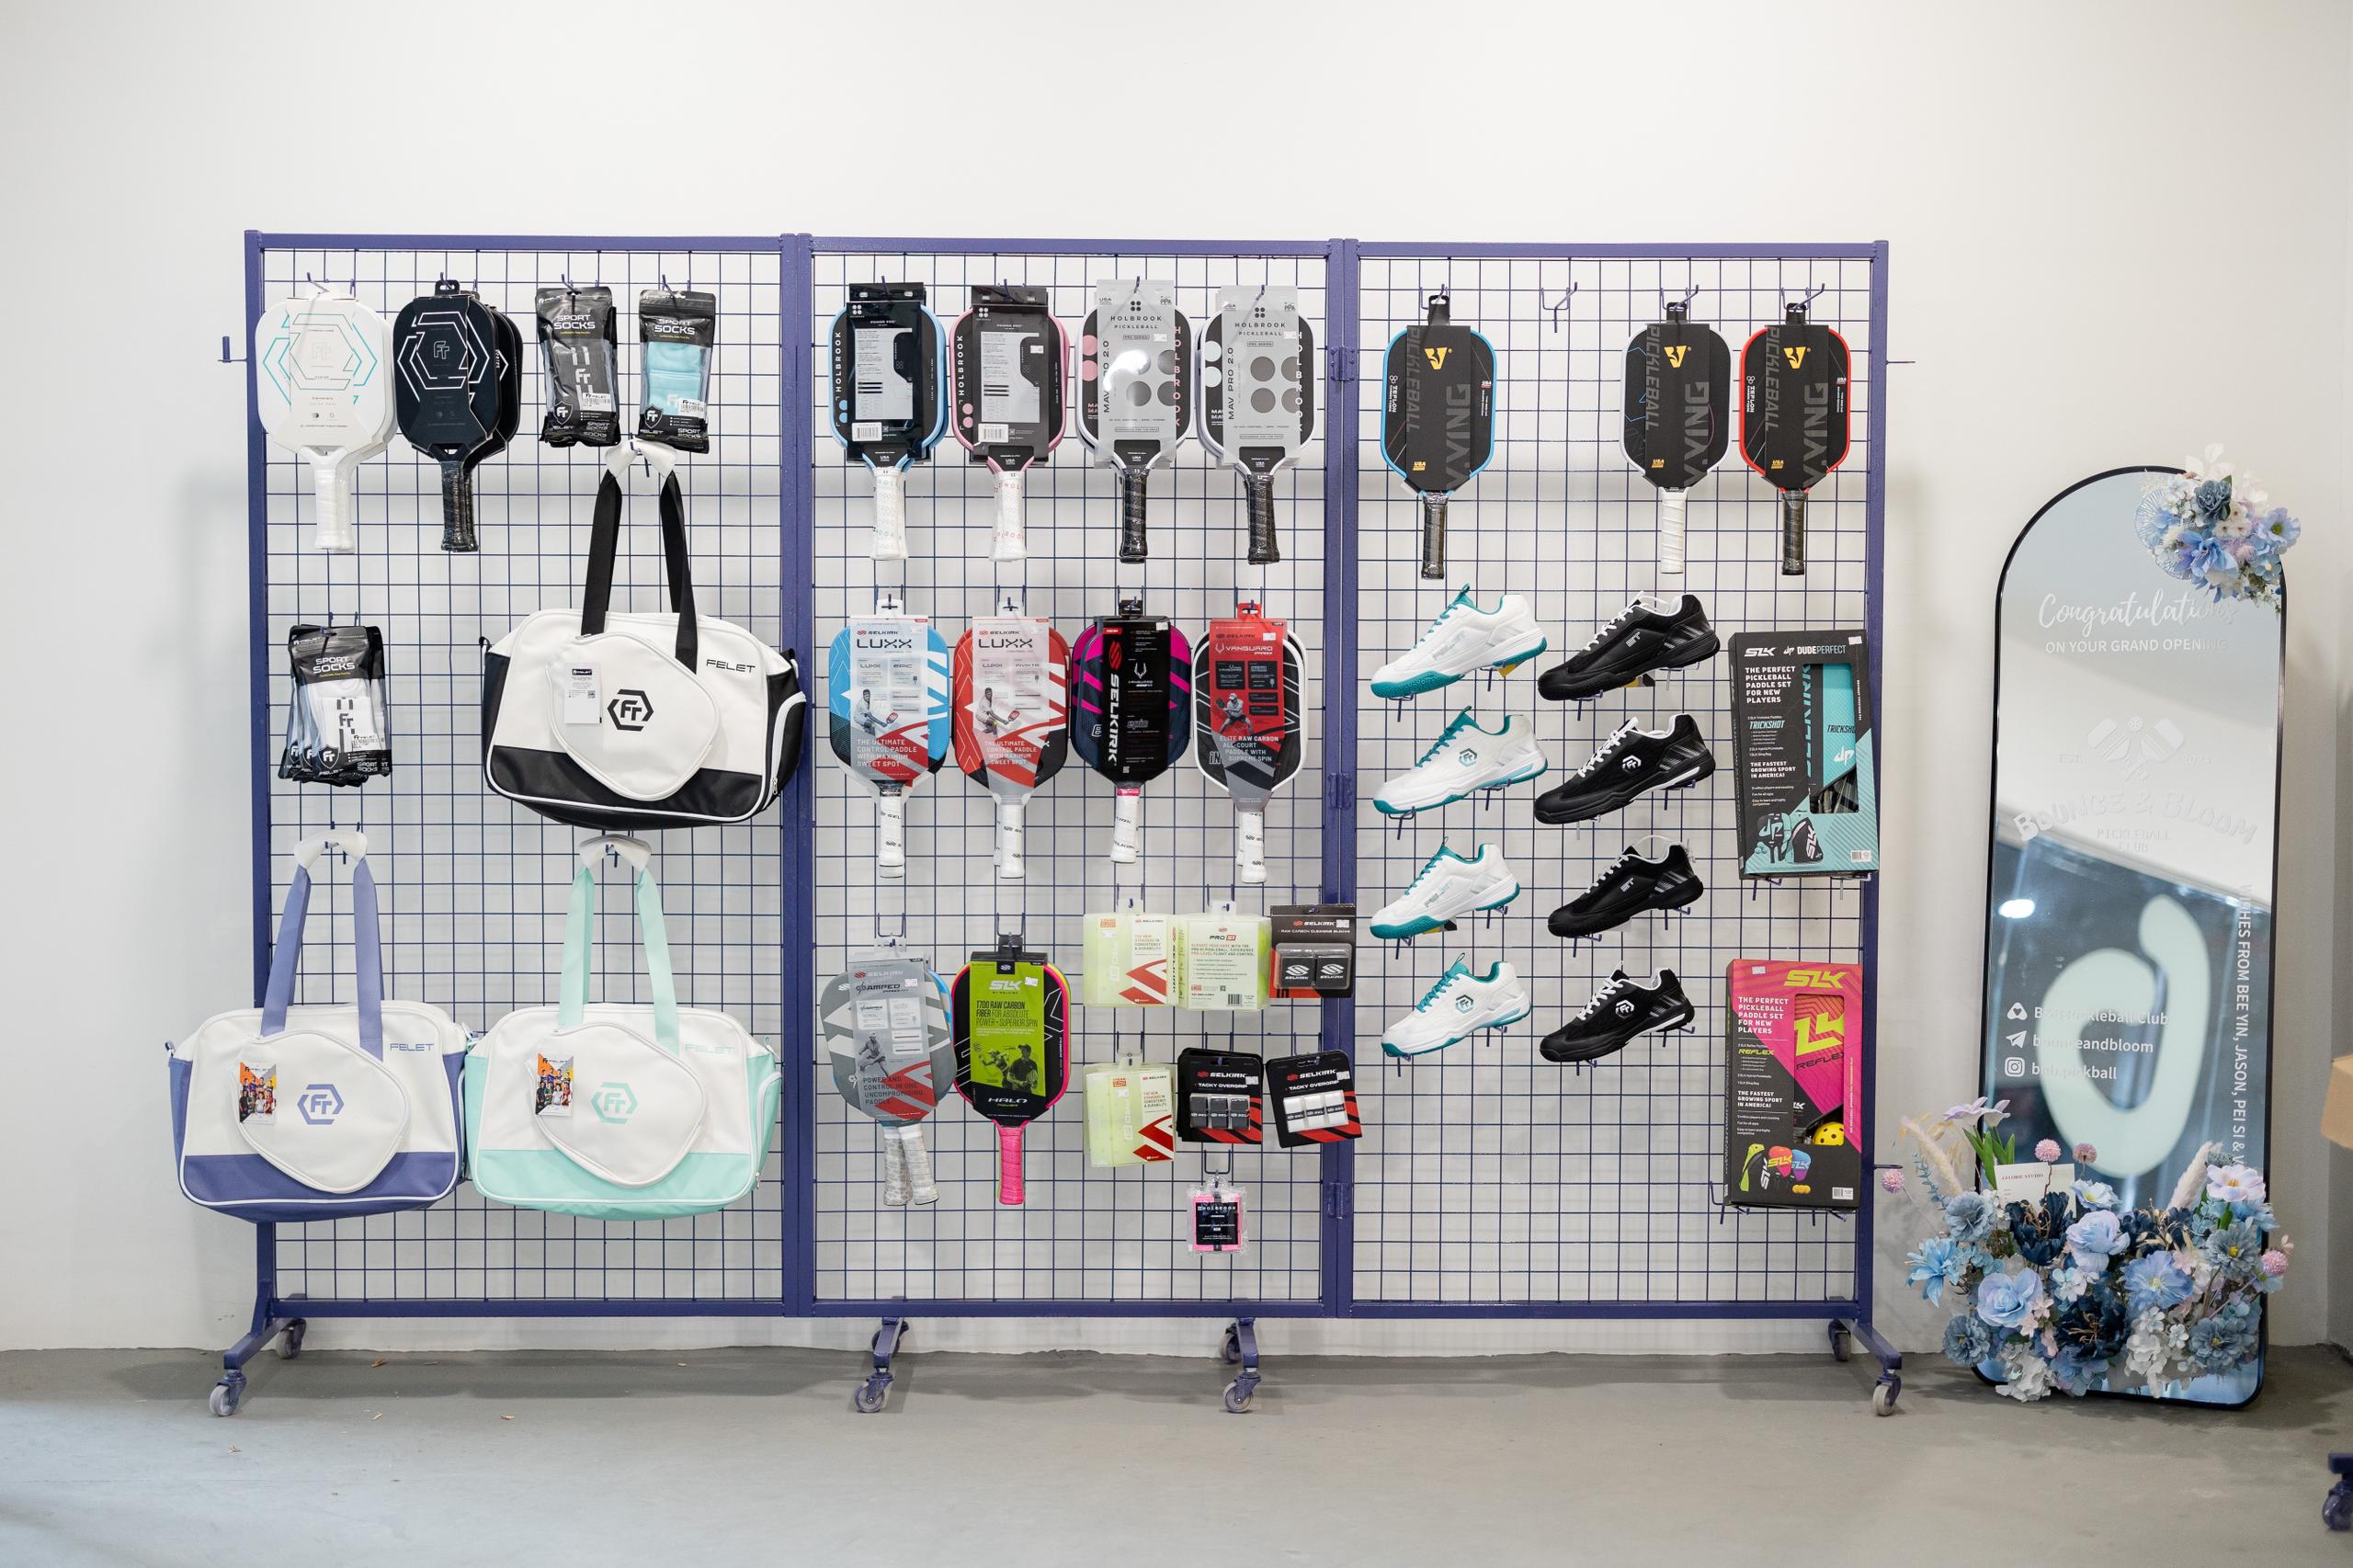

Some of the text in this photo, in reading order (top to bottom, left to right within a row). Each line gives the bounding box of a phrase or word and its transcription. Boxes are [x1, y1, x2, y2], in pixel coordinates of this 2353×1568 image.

[553, 322, 596, 330] SOCKS
[654, 324, 695, 335] SOCKS
[1406, 327, 1420, 433] PICKLEBALL
[1646, 324, 1660, 430] PICKLEBALL
[1766, 327, 1780, 432] PICKLEBALL
[857, 639, 912, 648] LUXX
[979, 639, 1032, 648] LUXX
[2045, 638, 2228, 654] ON YOUR GRAND OPENING
[1745, 645, 1846, 657] SLK DUDEPERFECT
[315, 656, 349, 665] SPORT
[706, 658, 756, 674] FELET
[313, 662, 355, 674] SOCKS
[620, 699, 642, 722] FT
[1108, 673, 1120, 766] SELKIRK
[1749, 721, 1785, 729] TRICKSHOT
[324, 750, 335, 762] FT
[2012, 788, 2259, 846] BOUNCE & BLOOM
[2097, 827, 2171, 840] PICKLEBALL
[1806, 825, 1817, 859] SLK
[2118, 842, 2149, 853] CLUB
[2237, 941, 2250, 982] FROM
[989, 980, 1022, 991] SLK
[1783, 971, 1849, 989] SLK
[976, 1000, 1026, 1009] T700 RAW CARBON
[2236, 985, 2249, 1011] BEE
[976, 1009, 991, 1017] FIBER
[1003, 1010, 1029, 1018] ABSOLUTE
[2137, 1012, 2168, 1025] Club
[999, 1018, 1025, 1027] SUPERIOR
[1026, 1019, 1039, 1028] SPIN
[2234, 1013, 2248, 1041] YIN,
[390, 1042, 435, 1051] FELET
[685, 1044, 735, 1053] FELET
[1300, 1069, 1336, 1078] SELKIRK
[2232, 1044, 2247, 1096] JASON,
[311, 1094, 333, 1115] FT
[603, 1093, 625, 1114] FT
[2234, 1099, 2246, 1121] PEI
[2233, 1125, 2245, 1138] SI
[2233, 1142, 2245, 1152] &
[1768, 1156, 1793, 1167] SLK
[1761, 1156, 1771, 1189] SLK
